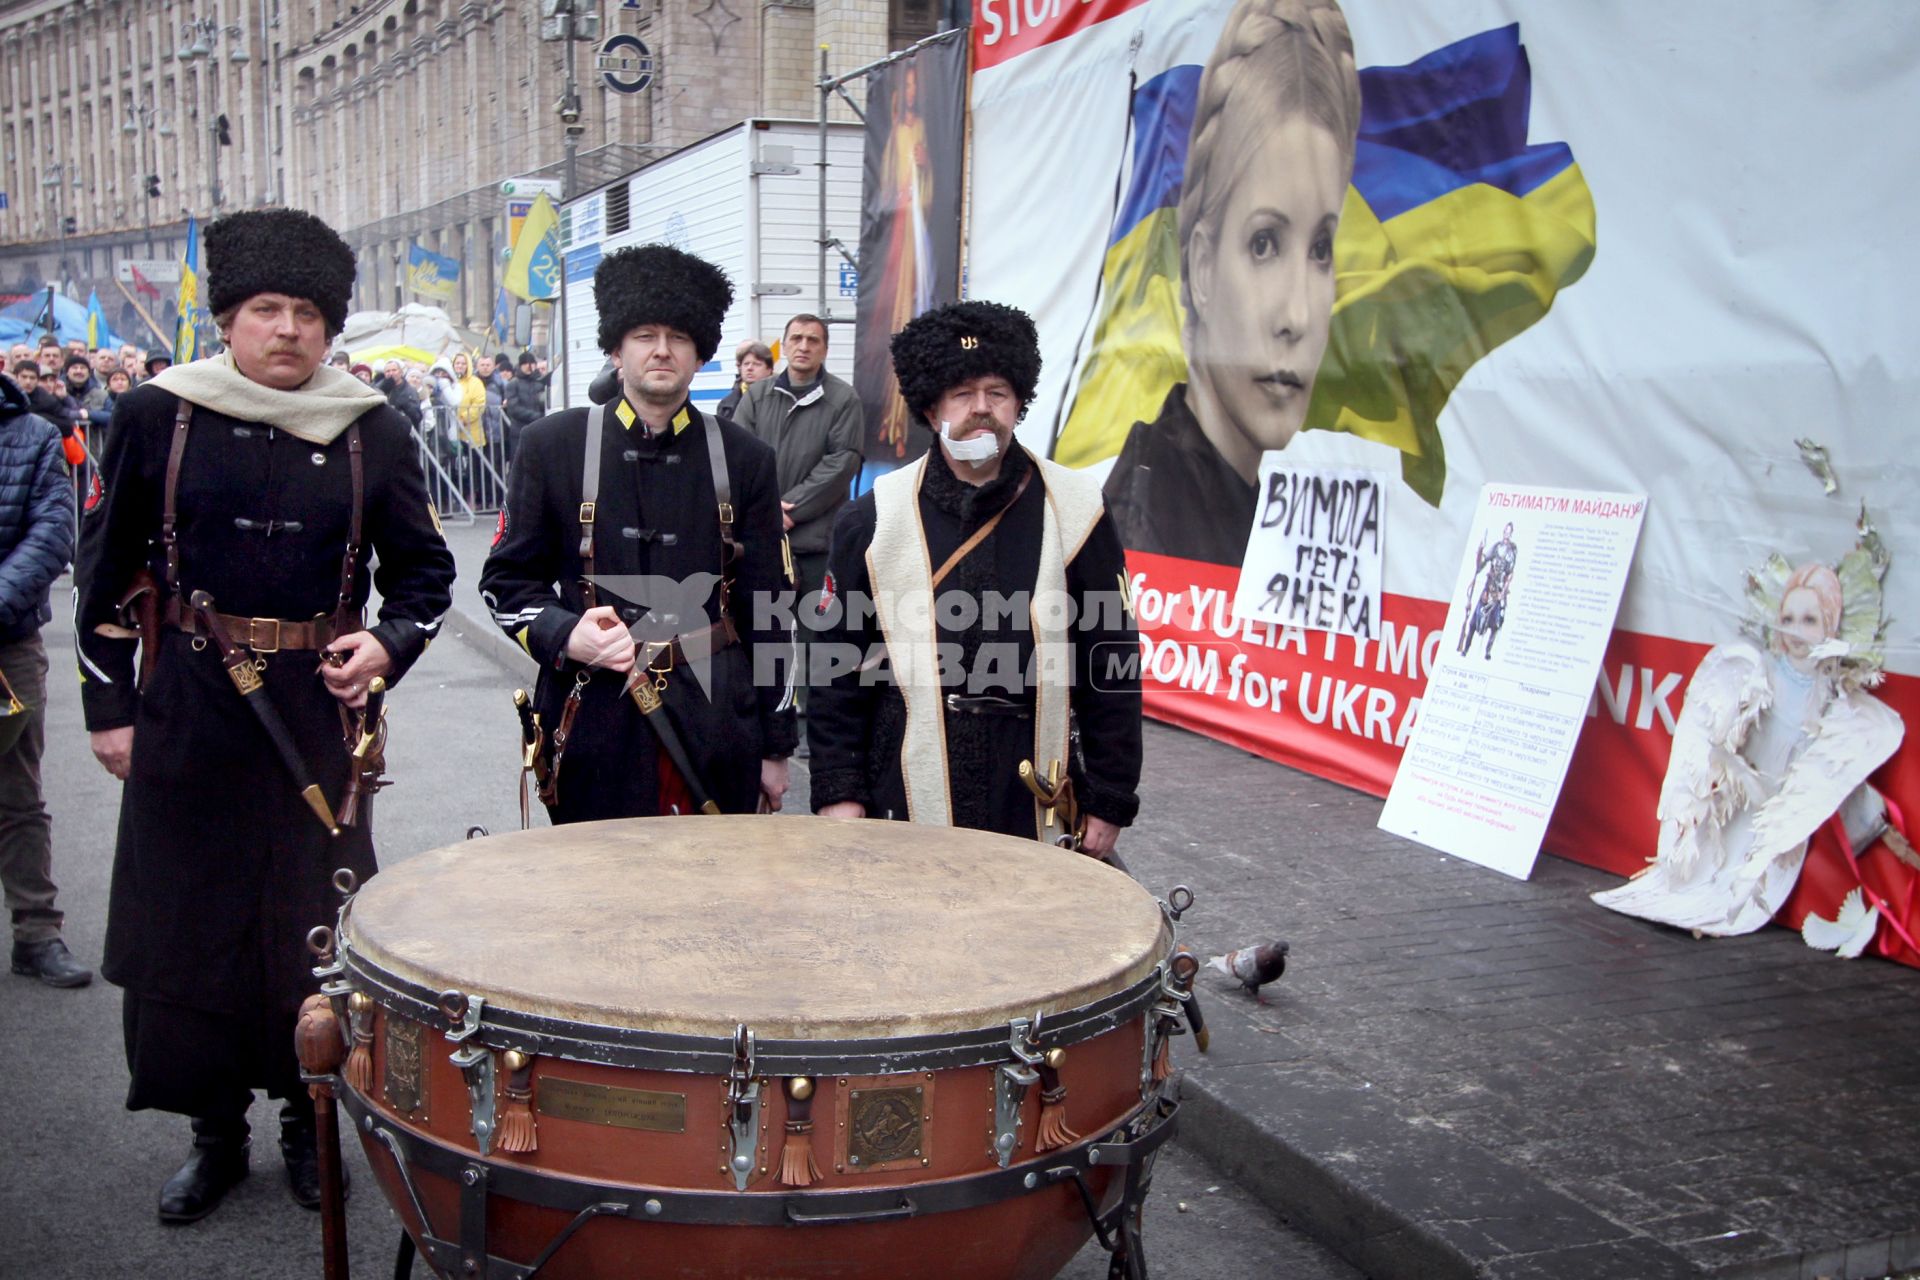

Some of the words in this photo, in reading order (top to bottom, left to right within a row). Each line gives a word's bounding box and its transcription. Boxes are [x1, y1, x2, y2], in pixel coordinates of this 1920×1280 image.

[1261, 472, 1379, 555] ВИМОГА
[1488, 492, 1570, 513] УЛЬТИМАТУМ
[1296, 544, 1361, 591] ГЕТЬ
[1131, 572, 1182, 625] for
[1258, 573, 1371, 639] ЯНЕКА
[1227, 653, 1288, 713] for
